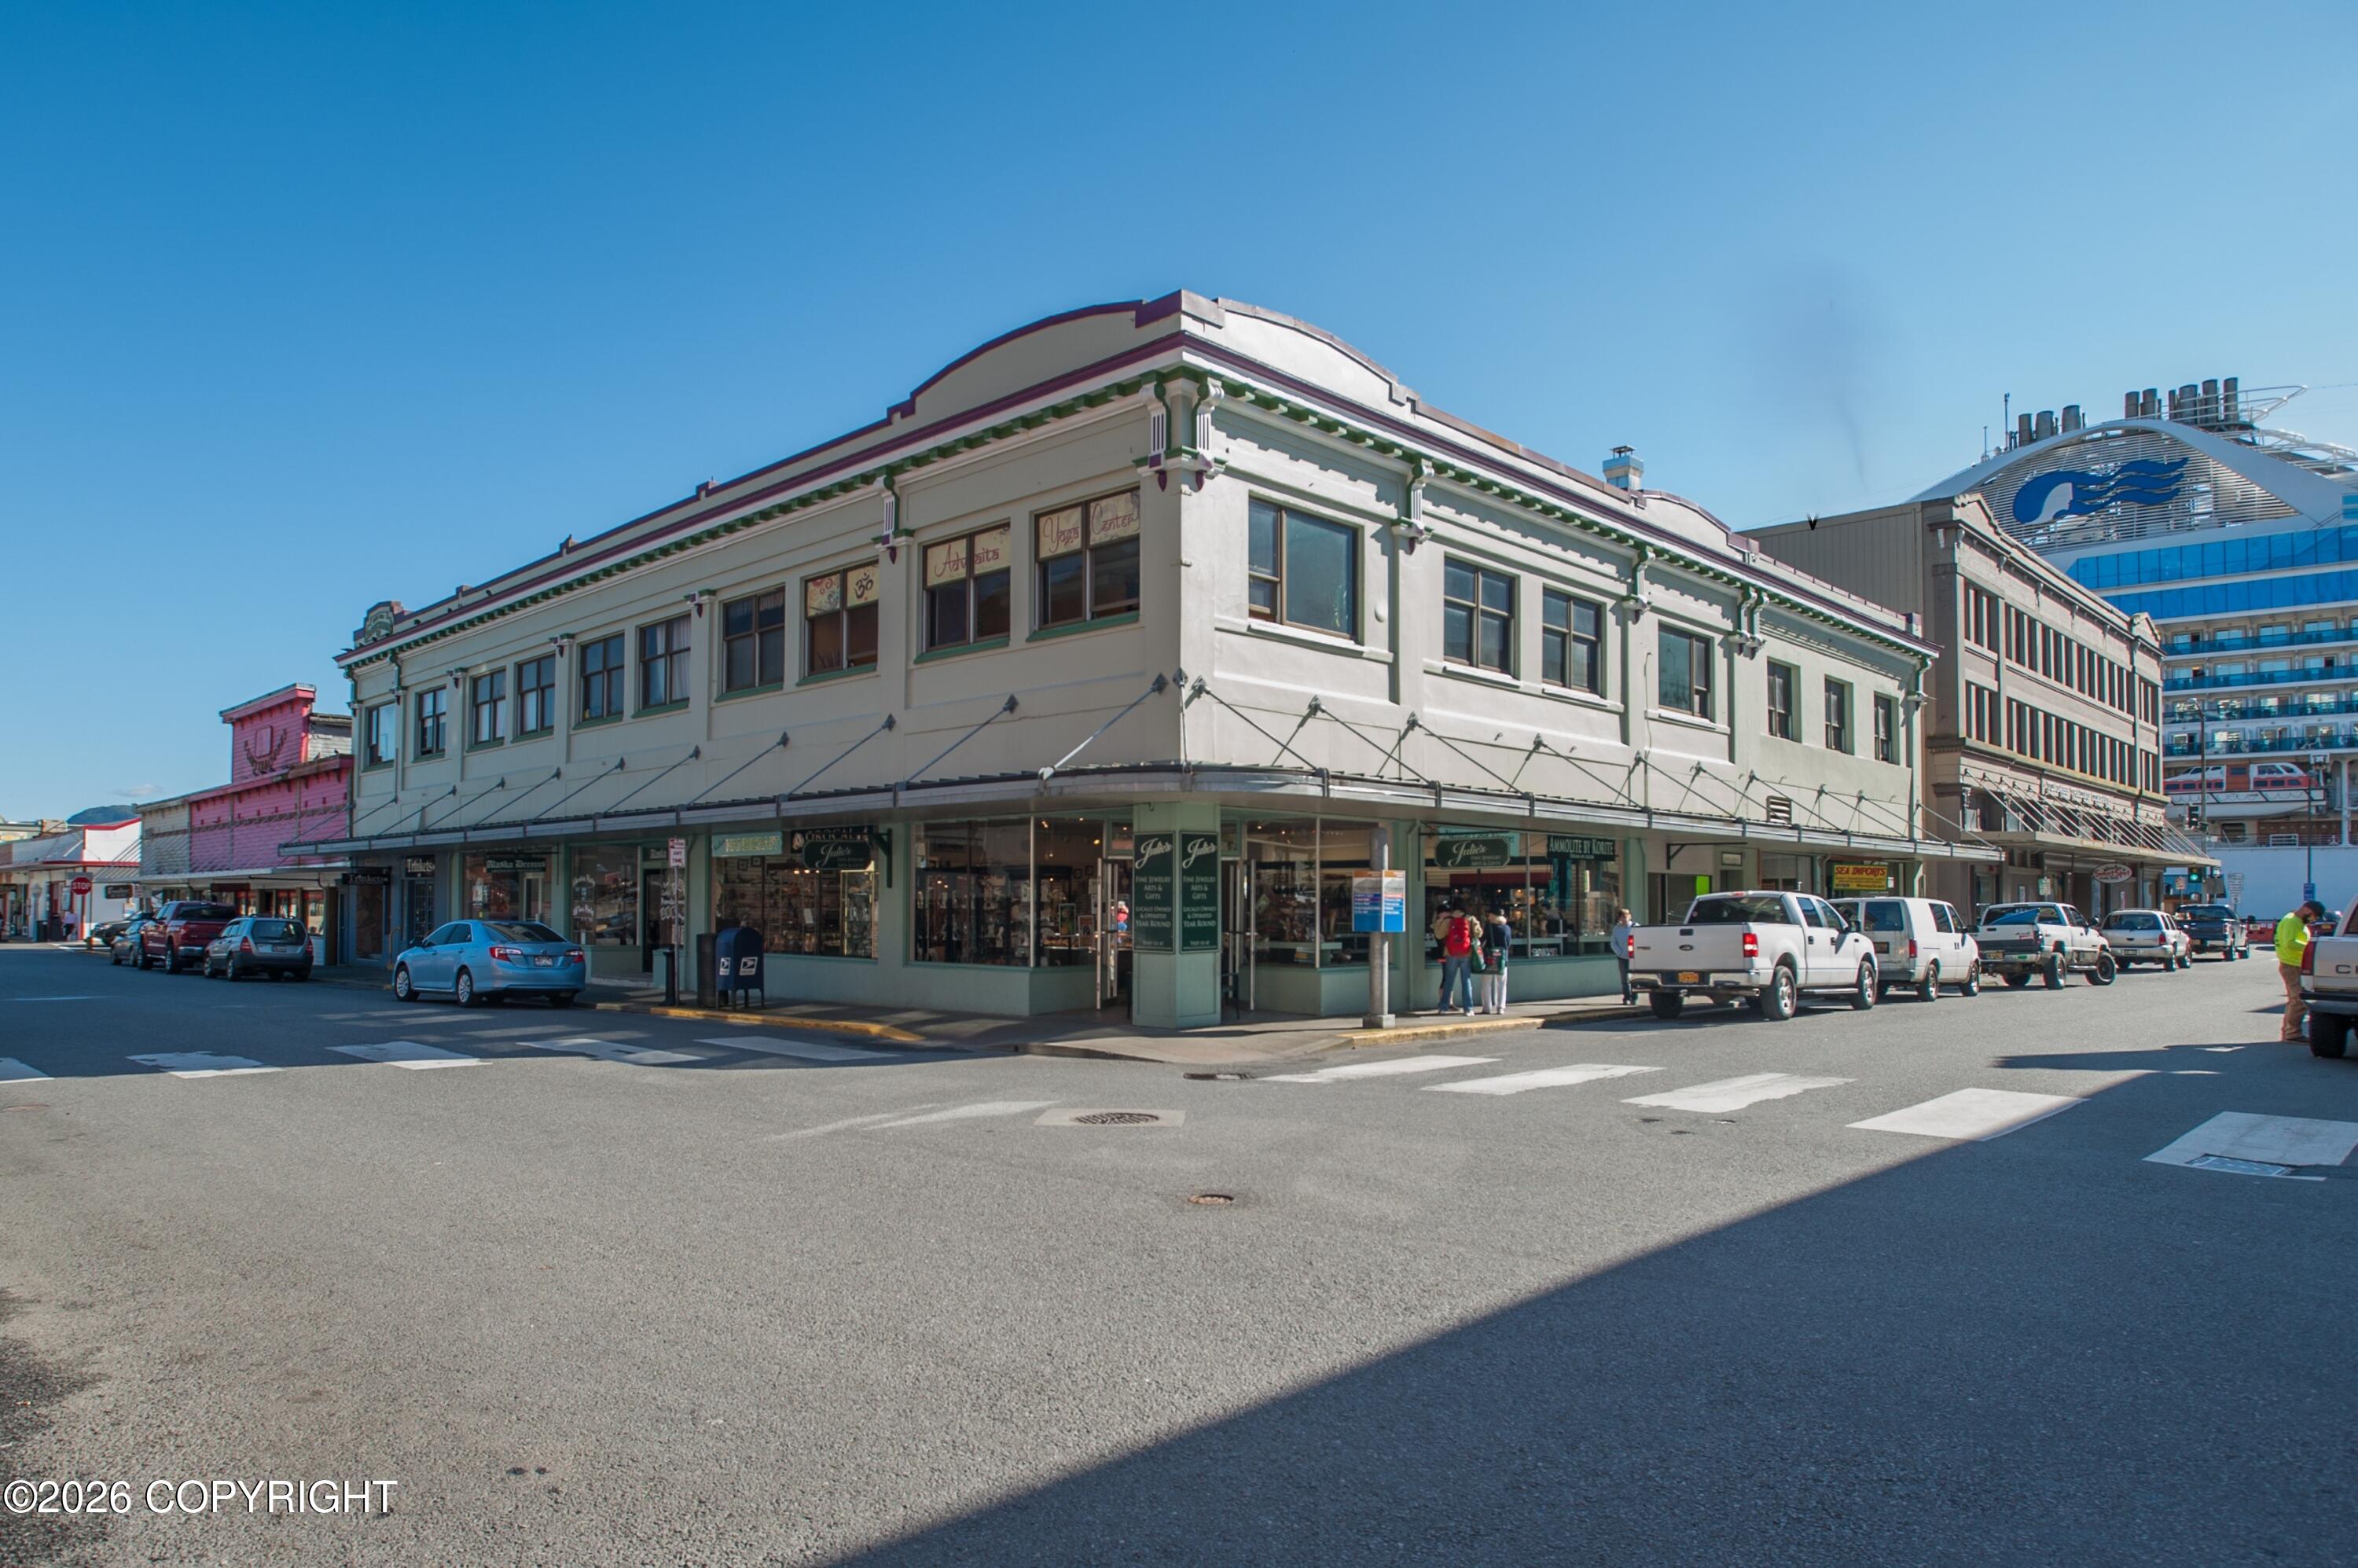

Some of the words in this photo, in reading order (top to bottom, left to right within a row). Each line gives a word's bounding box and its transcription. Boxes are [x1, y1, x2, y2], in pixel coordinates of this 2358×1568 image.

[1043, 515, 1080, 553] Yoga
[1092, 503, 1138, 535] Center
[815, 842, 852, 868] Julie's
[1135, 837, 1173, 868] Julie's
[1182, 837, 1217, 868] Julie's
[1448, 840, 1486, 866] Julie's
[1549, 836, 1582, 854] AMMOLITE
[1583, 839, 1591, 854] BY
[1592, 839, 1614, 855] KORITE
[1853, 867, 1886, 876] IMPORTS
